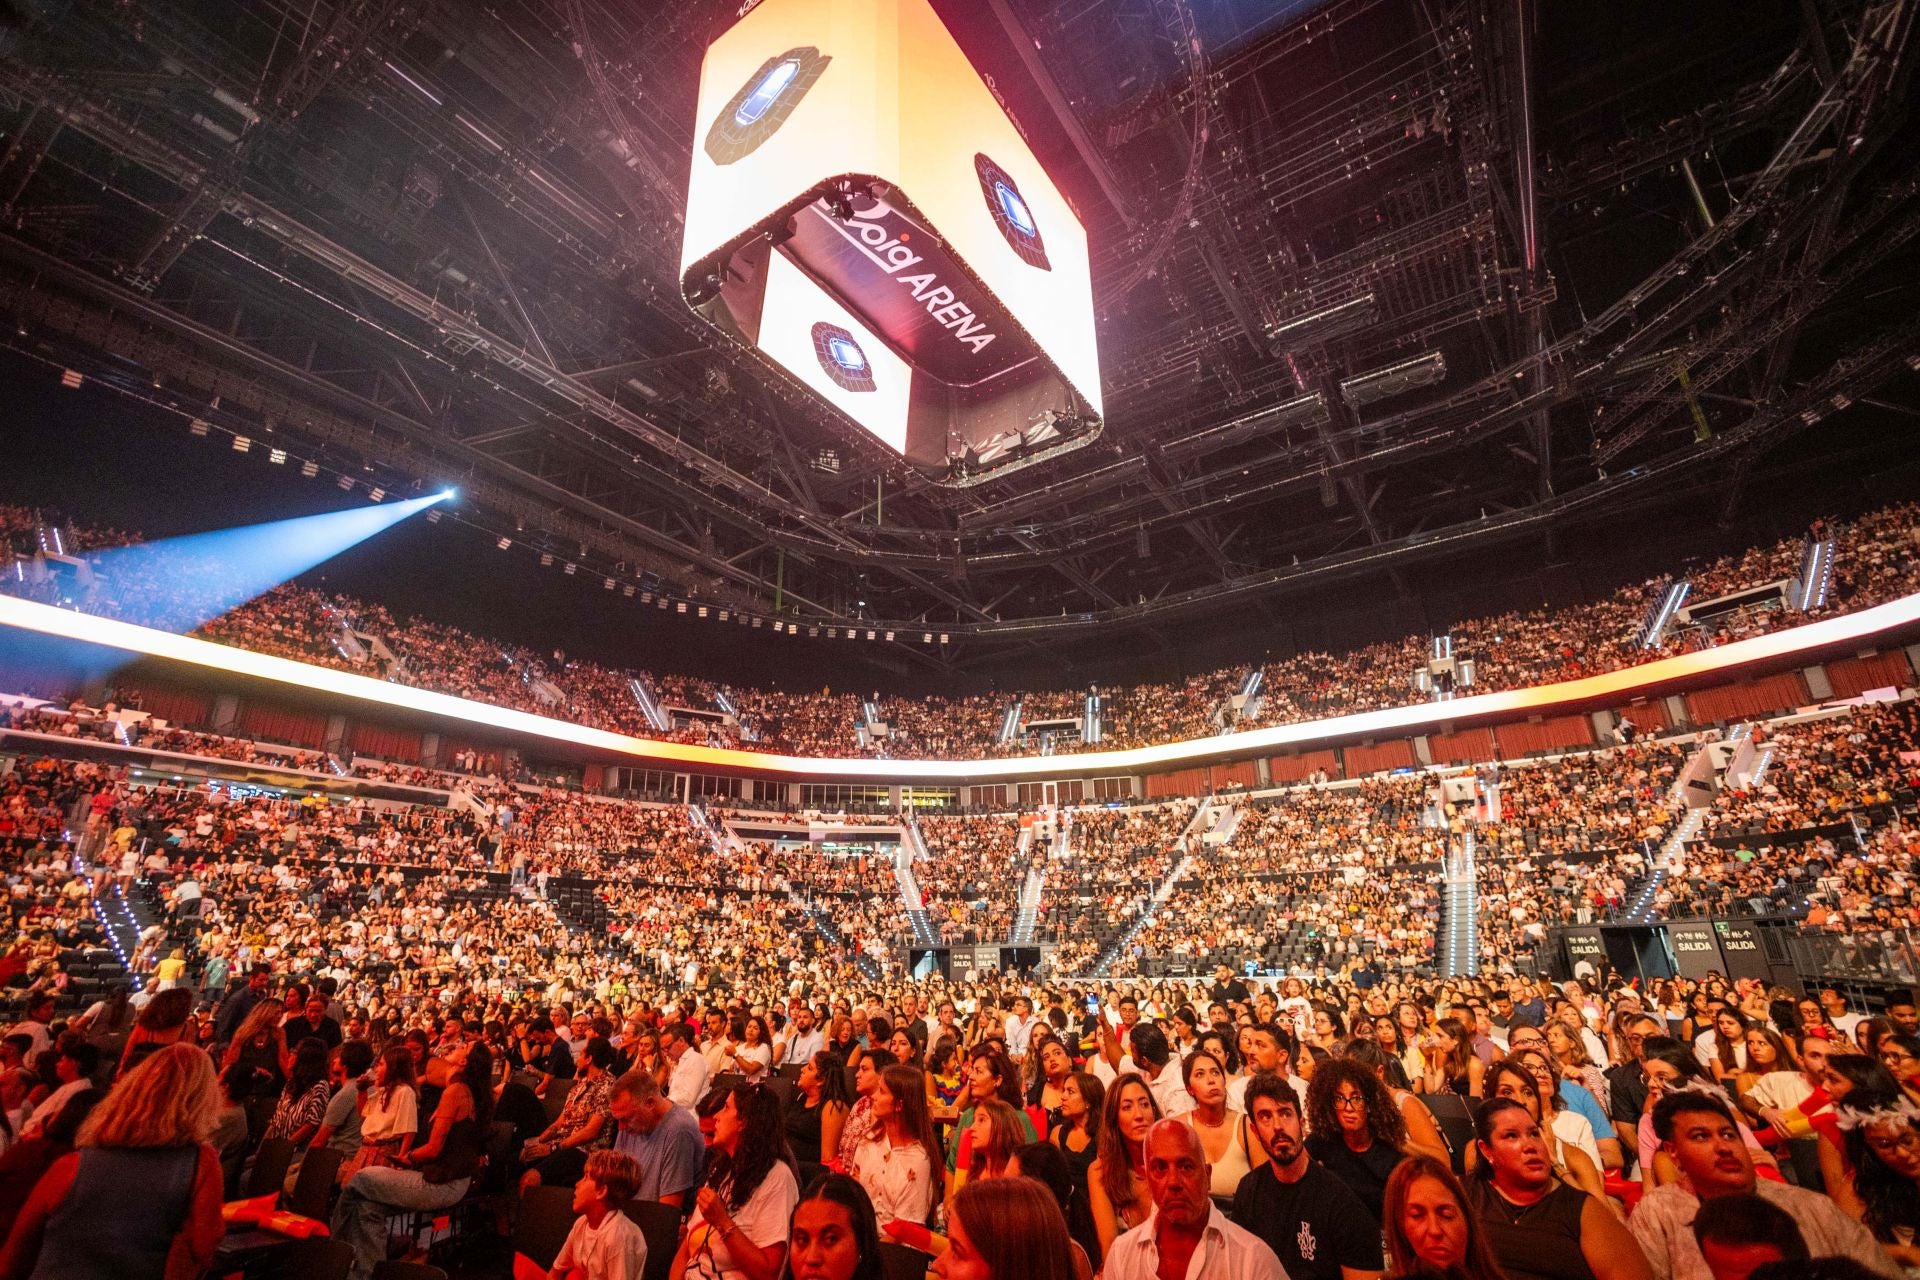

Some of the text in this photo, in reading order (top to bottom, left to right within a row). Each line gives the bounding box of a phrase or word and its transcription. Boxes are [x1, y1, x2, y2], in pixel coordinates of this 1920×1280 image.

[896, 273, 996, 354] ARENA
[1571, 945, 1600, 954] SALIDA
[1677, 941, 1712, 951] SALIDA
[1725, 940, 1756, 950] SALIDA
